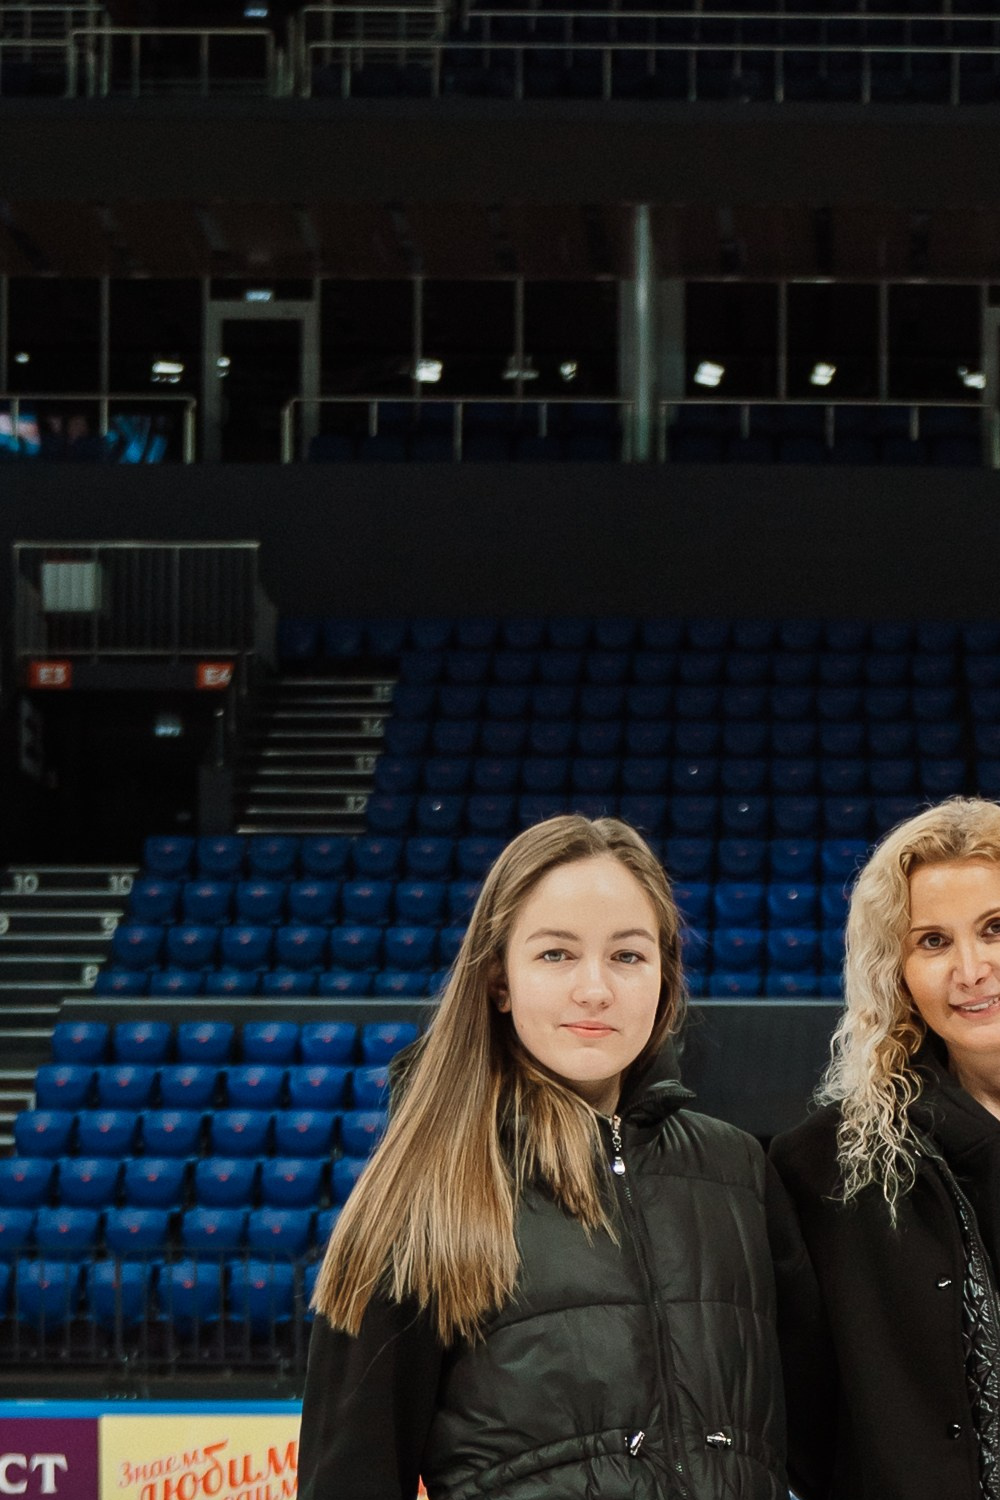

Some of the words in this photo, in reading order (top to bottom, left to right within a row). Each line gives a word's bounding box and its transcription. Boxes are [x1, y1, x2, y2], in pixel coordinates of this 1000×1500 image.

[13, 874, 39, 893] 10
[108, 874, 134, 893] 10
[103, 914, 118, 935] 9
